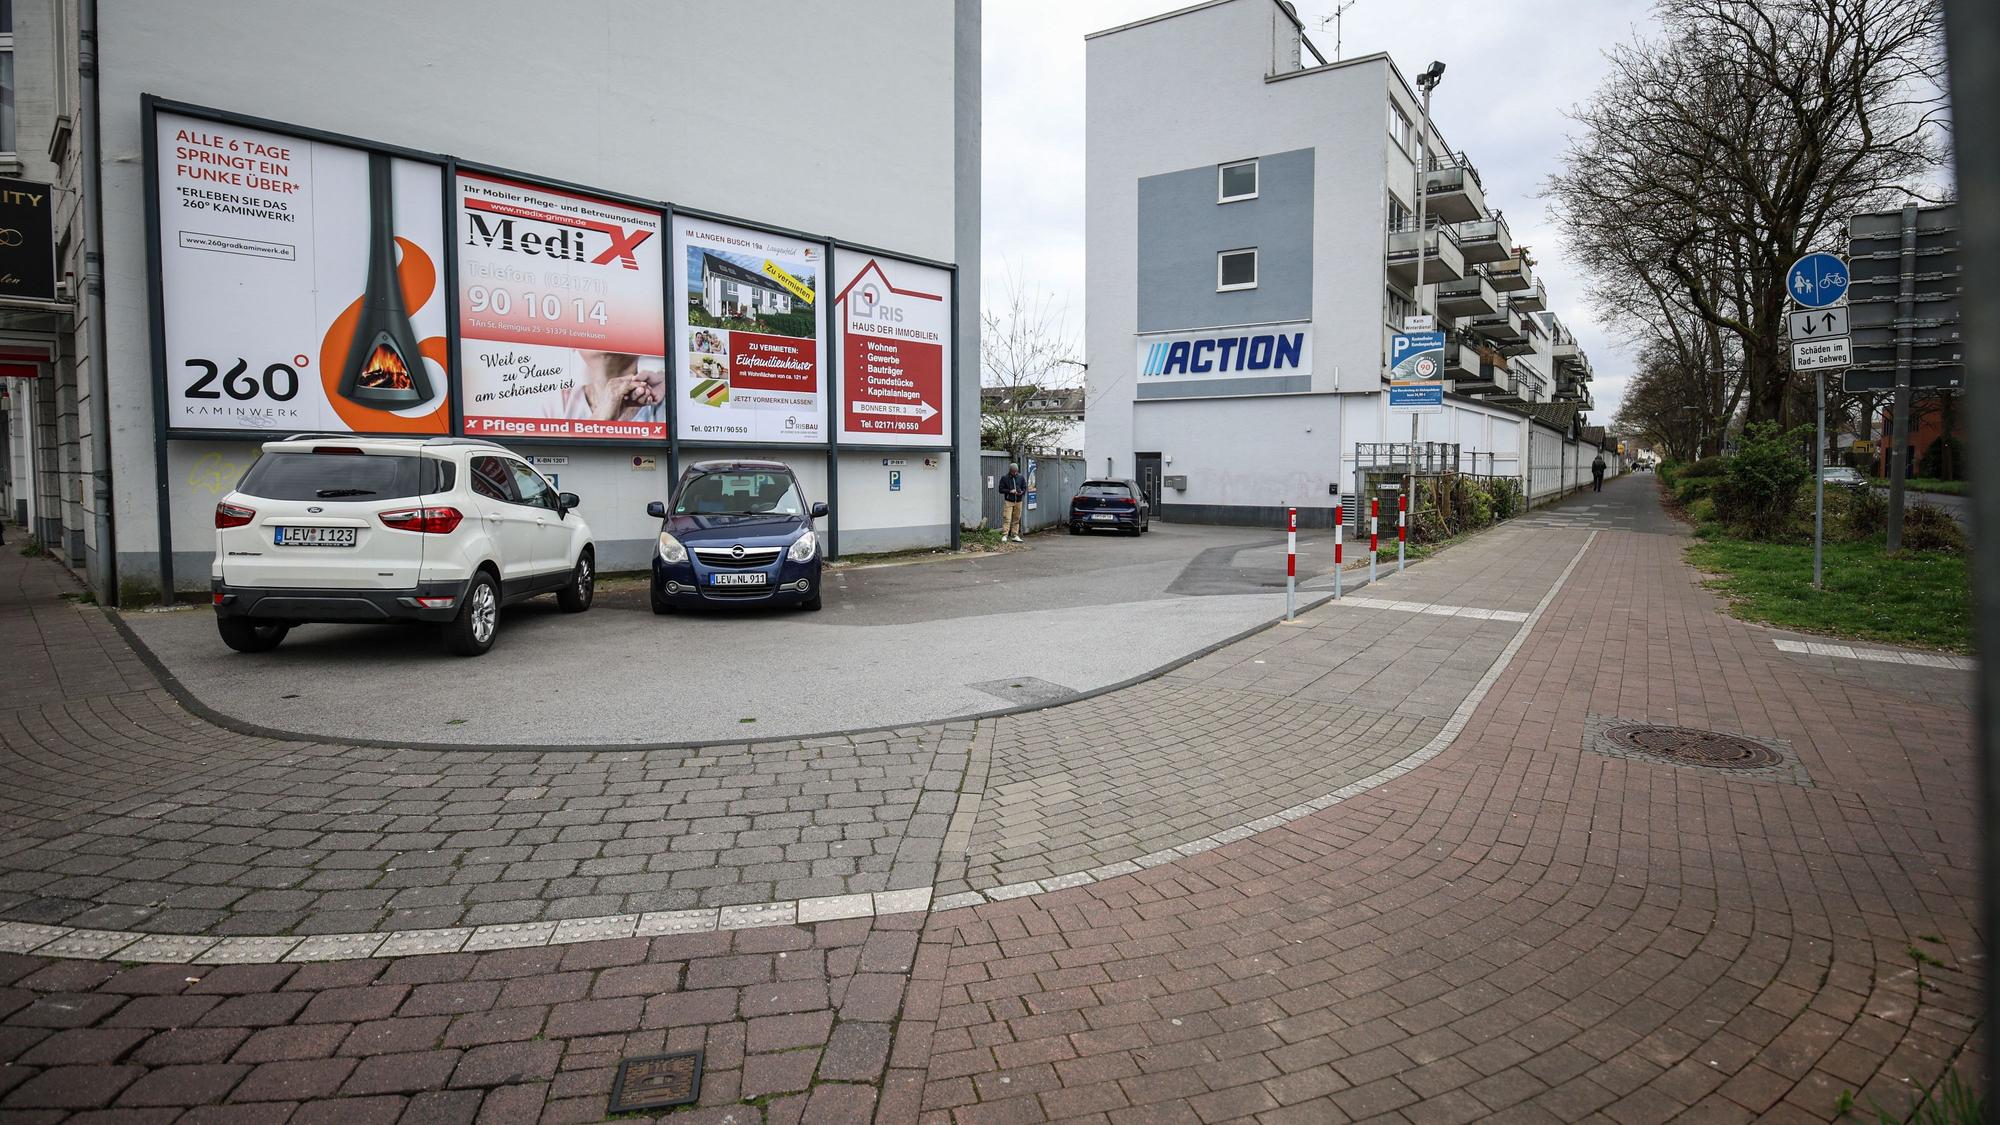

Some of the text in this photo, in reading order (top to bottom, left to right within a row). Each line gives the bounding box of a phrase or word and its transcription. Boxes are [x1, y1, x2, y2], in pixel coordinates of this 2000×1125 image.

[176, 129, 290, 161] ALLE 6 TAGE
[176, 146, 288, 177] SPRINGT EIN
[177, 164, 242, 186] FUNKE
[183, 199, 295, 223] 260° KAMINWERK!
[242, 196, 260, 207] SIE
[263, 200, 288, 211] DAS
[463, 184, 657, 229] Ihr Mobiler Pflege- und Betreuungsdienst
[490, 203, 587, 226] www.medix-grimm.de
[186, 237, 290, 256] www.260gradkaminwerk.de
[685, 229, 695, 237] IM
[695, 231, 725, 243] LANGEN
[726, 237, 751, 247] BUSCH
[752, 242, 763, 250] 19a
[468, 261, 536, 285] Telefon
[766, 264, 811, 300] Zu vermieten
[468, 285, 608, 326] 90 10 14
[880, 305, 904, 322] RIS
[487, 320, 497, 329] St.
[498, 322, 530, 333] Remigius
[569, 330, 606, 339] Leverkusen
[852, 321, 939, 341] HAUS DER IMMOBILIEN
[749, 342, 799, 354] ZU VERMIETEN:
[867, 341, 897, 353] Wohnen
[1163, 333, 1304, 375] ACTION
[1394, 337, 1409, 358] P
[1800, 346, 1830, 355] Schäden
[480, 351, 532, 368] Weil es
[735, 353, 814, 371] Einfamilienhäuser
[867, 353, 900, 364] Gewerbe
[1798, 354, 1847, 366] Rad- Gehweg
[502, 364, 563, 382] zu Hause
[867, 364, 904, 376] Bauträger
[475, 378, 575, 403] am schönsten ist
[867, 376, 914, 387] Grundstücke
[752, 396, 789, 404] VORMERKEN
[868, 387, 920, 400] Kapitalanlagen
[186, 406, 298, 417] KAMINWERK
[861, 404, 887, 412] BONNER
[482, 419, 536, 433] Pflege
[540, 421, 570, 433] und
[574, 422, 650, 437] Betreuung
[861, 420, 874, 428] Tel.
[891, 472, 899, 484] P
[283, 529, 310, 541] LEV
[318, 529, 325, 541] I
[328, 529, 353, 542] 123
[716, 574, 765, 584] LEV NL 911
